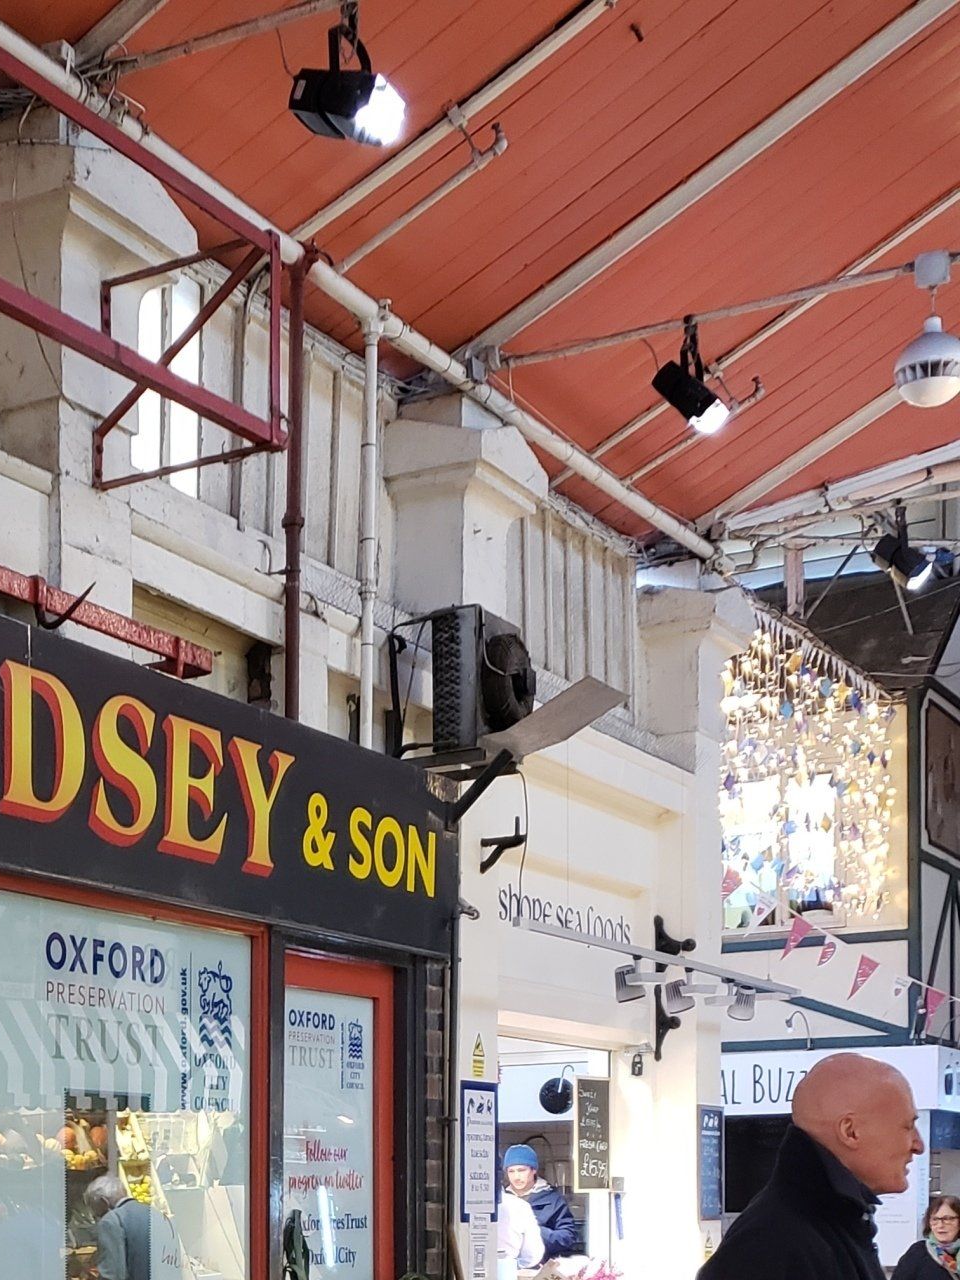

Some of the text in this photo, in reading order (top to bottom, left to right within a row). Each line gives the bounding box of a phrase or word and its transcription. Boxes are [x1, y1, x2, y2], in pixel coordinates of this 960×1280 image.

[302, 791, 336, 871] &
[348, 806, 436, 898] SON
[45, 930, 167, 985] OXFORD
[46, 980, 166, 1016] PRESERVATION
[288, 1031, 336, 1045] PRESERVATION
[289, 1009, 335, 1031] OXFORD
[46, 1012, 164, 1068] TRUST
[289, 1045, 335, 1069] TRUST
[752, 1064, 808, 1104] BUZ
